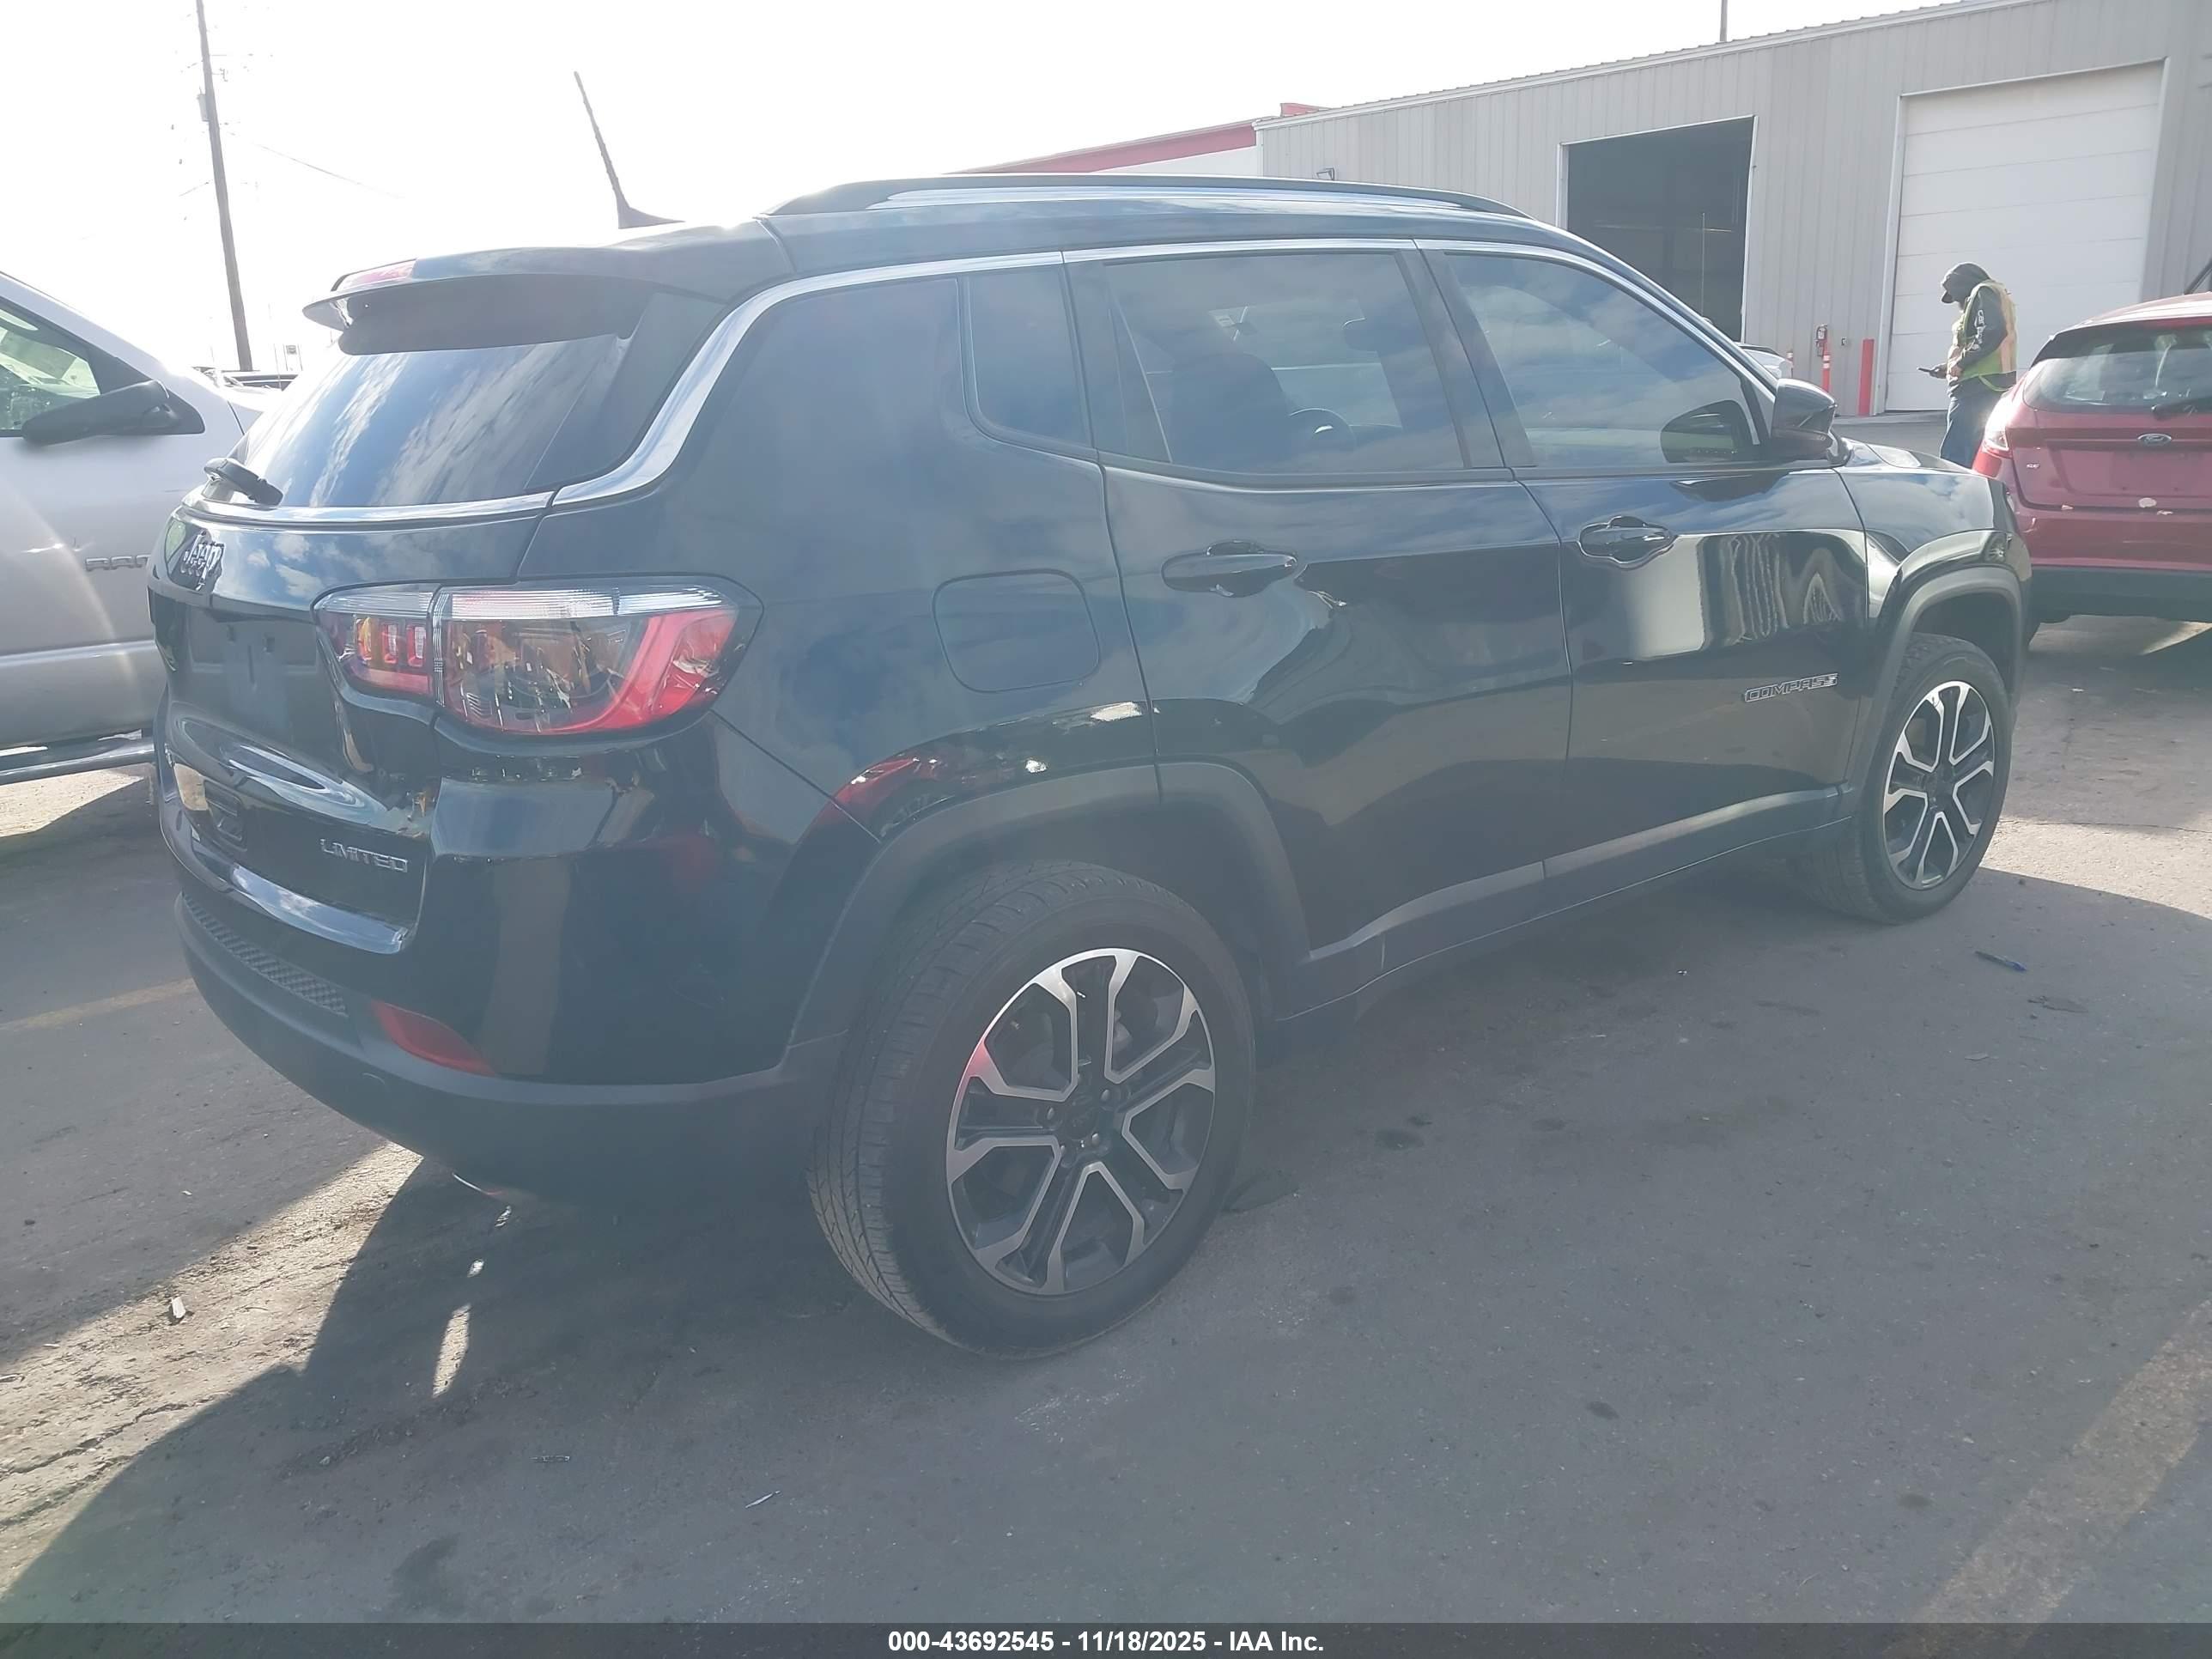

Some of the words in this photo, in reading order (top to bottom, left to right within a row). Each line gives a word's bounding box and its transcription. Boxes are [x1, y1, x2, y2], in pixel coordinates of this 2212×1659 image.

[182, 532, 224, 585] Jeep
[1745, 673, 1838, 702] COMPASS
[320, 838, 408, 872] LIMITED
